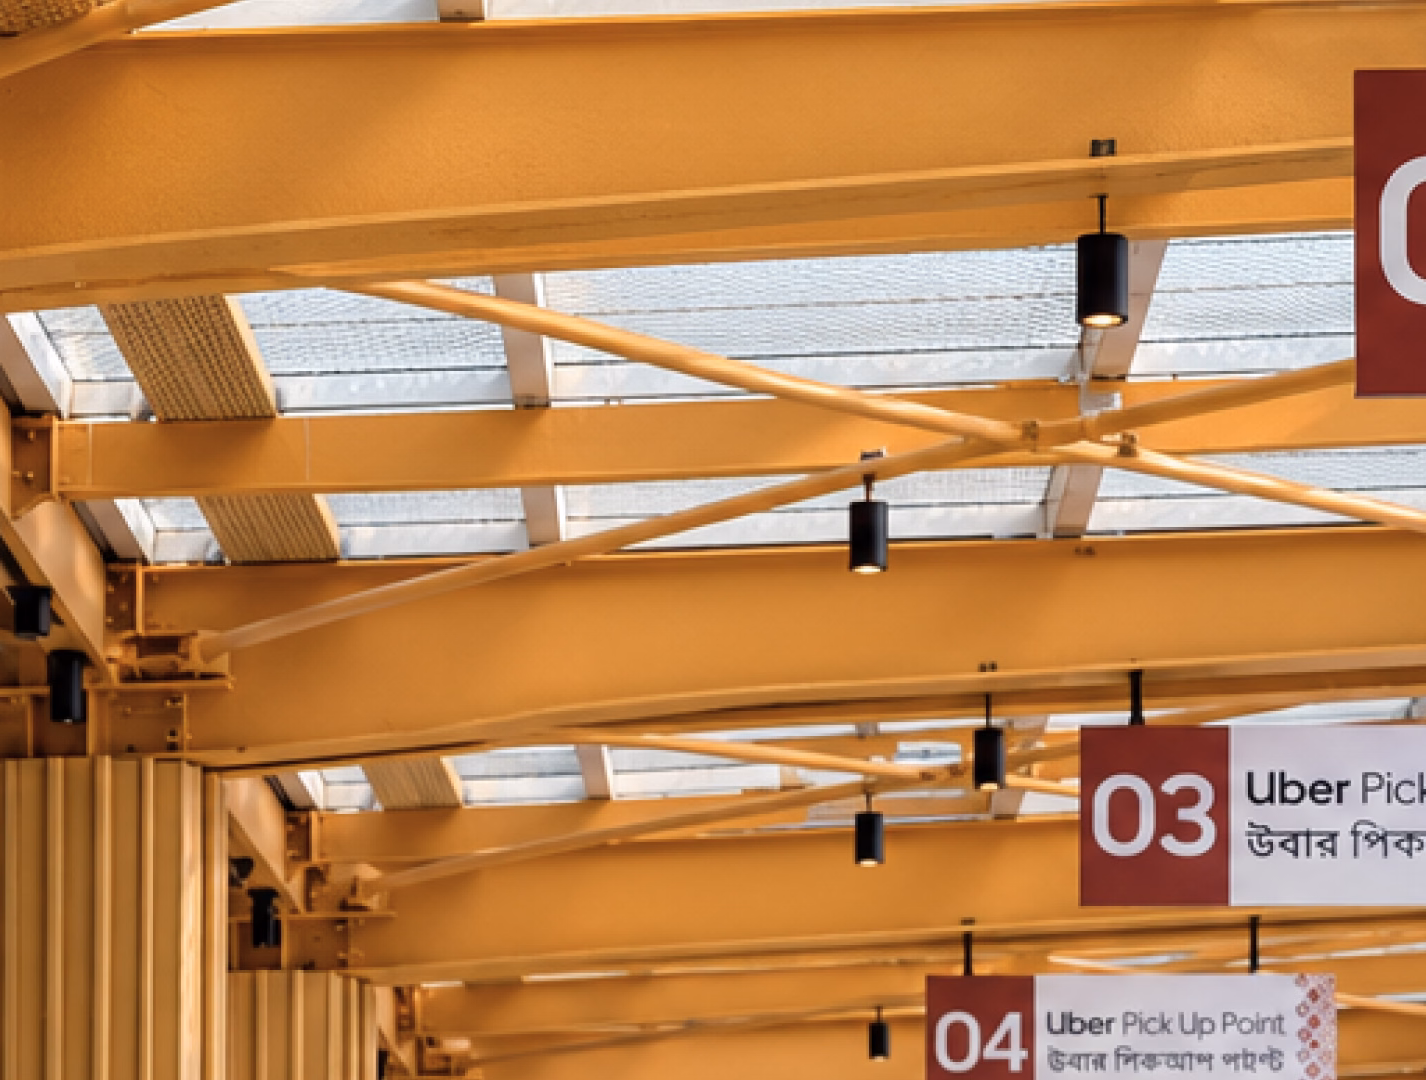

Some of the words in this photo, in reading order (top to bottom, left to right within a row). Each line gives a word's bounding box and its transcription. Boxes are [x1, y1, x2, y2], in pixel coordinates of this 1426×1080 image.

[1248, 770, 1351, 806] Uber
[1092, 773, 1217, 856] 03
[1245, 822, 1340, 859] উবার
[936, 1012, 1028, 1073] 04
[1047, 1012, 1115, 1034] Uber
[1123, 1012, 1172, 1034] Pick
[1179, 1012, 1215, 1039] Up
[1223, 1012, 1284, 1034] Point
